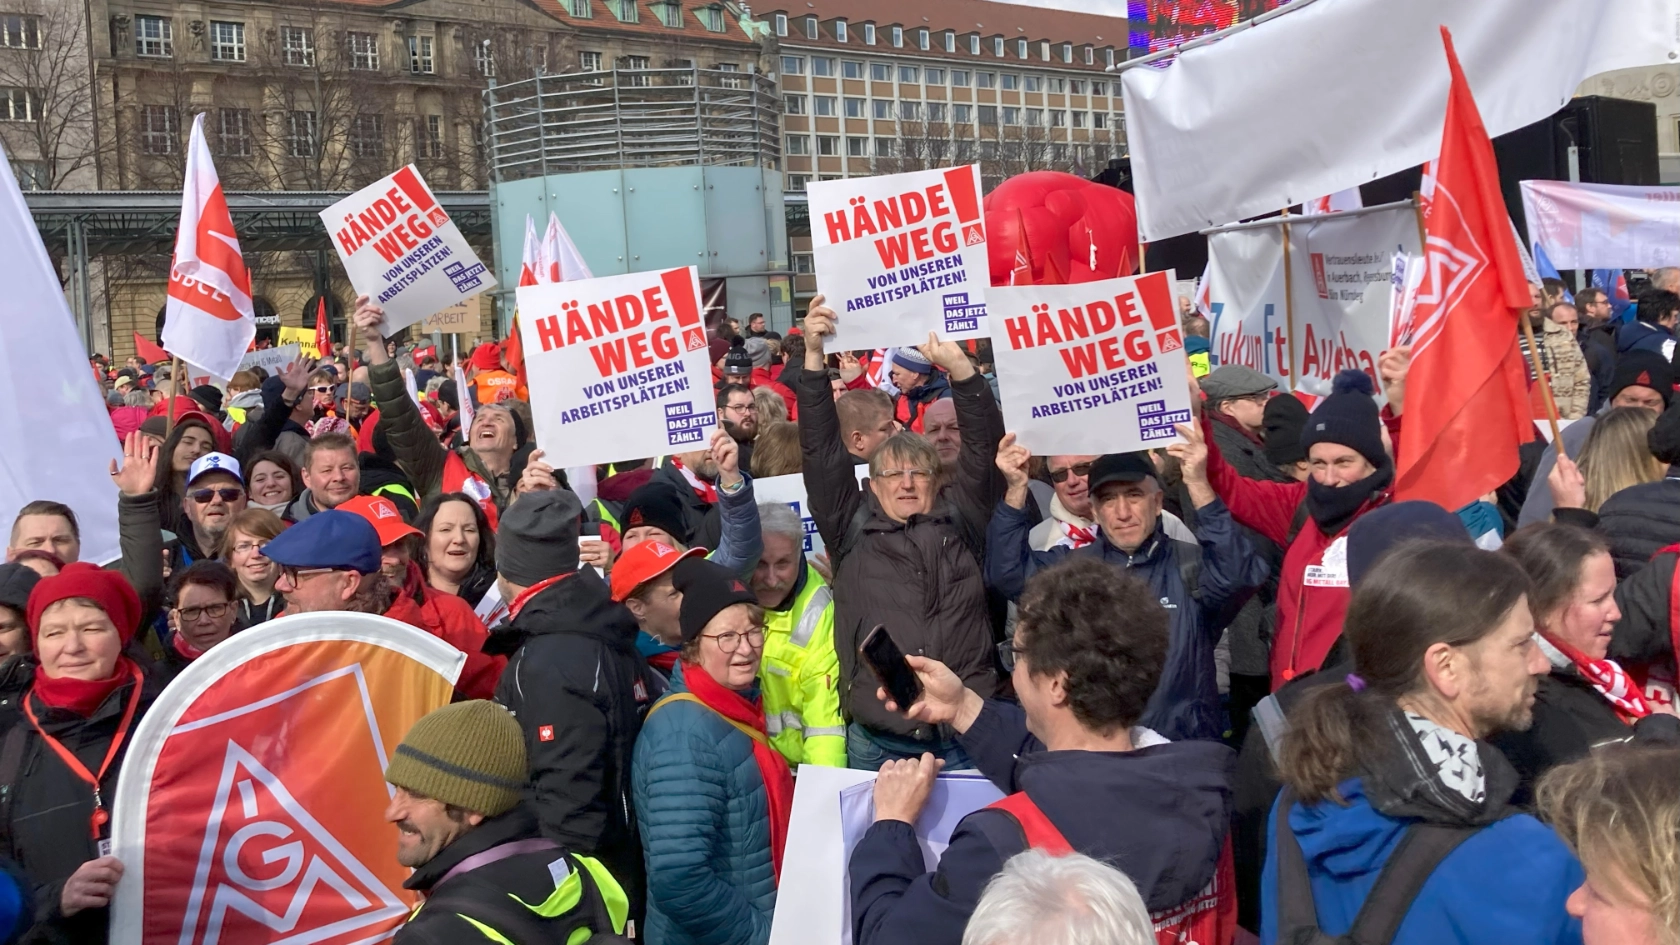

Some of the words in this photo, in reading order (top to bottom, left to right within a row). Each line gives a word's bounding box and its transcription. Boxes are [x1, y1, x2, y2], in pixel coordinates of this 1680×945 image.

[336, 187, 412, 256] HÄNDE
[824, 183, 950, 244] HÄNDE
[382, 262, 405, 282] VON
[401, 235, 443, 269] UNSEREN
[445, 264, 463, 276] WEIL
[867, 272, 897, 290] VON
[900, 254, 963, 281] UNSEREN
[377, 245, 453, 304] ARBEITSPLÄTZEN!
[452, 273, 466, 284] DAS
[464, 266, 484, 280] JETZT
[847, 270, 967, 312] ARBEITSPLÄTZEN!
[944, 295, 966, 306] WEIL
[428, 312, 468, 326] ARBEIT
[535, 286, 669, 352] HÄNDE
[946, 308, 963, 318] DAS
[947, 320, 976, 331] ZÄHLT.
[1004, 291, 1142, 350] HÄNDE
[582, 380, 615, 399] VON
[617, 360, 685, 390] UNSEREN
[1053, 381, 1086, 398] VON
[1088, 362, 1158, 391] UNSEREN
[561, 377, 690, 424] ARBEITSPLÄTZEN!
[667, 405, 690, 416] WEIL
[1032, 377, 1163, 419] ARBEITSPLÄTZEN!
[1138, 403, 1163, 413] WEIL
[669, 419, 687, 429] DAS
[688, 414, 714, 428] JETZT
[1140, 417, 1161, 427] DAS
[1161, 412, 1189, 425] JETZT
[1142, 427, 1174, 439] ZÄHLT.
[670, 431, 701, 443] ZÄHLT.
